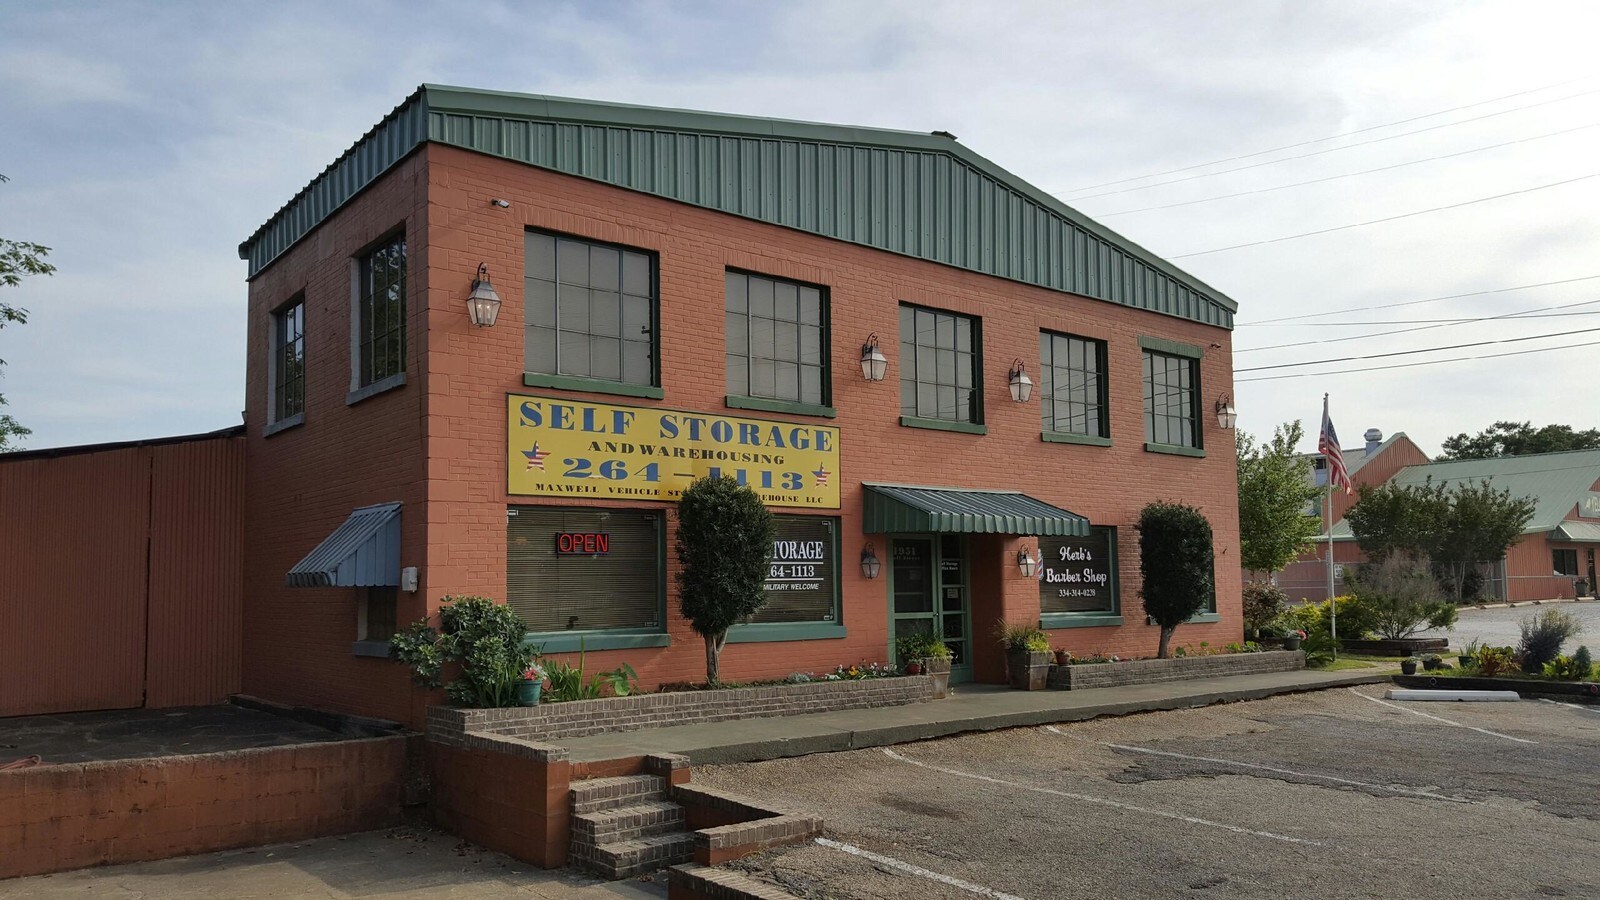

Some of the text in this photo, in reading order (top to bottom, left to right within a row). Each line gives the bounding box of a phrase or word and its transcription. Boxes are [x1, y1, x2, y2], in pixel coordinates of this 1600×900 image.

[519, 399, 833, 453] SELF STORAGE
[535, 483, 600, 493] MAXWELL
[609, 486, 661, 496] VEHICLE
[806, 496, 824, 504] LLC
[559, 533, 608, 552] OPEN
[767, 540, 824, 560] TORAGE
[1059, 546, 1092, 561] Herb's
[767, 564, 815, 578] 64-1113
[1046, 568, 1107, 587] Barber Shop
